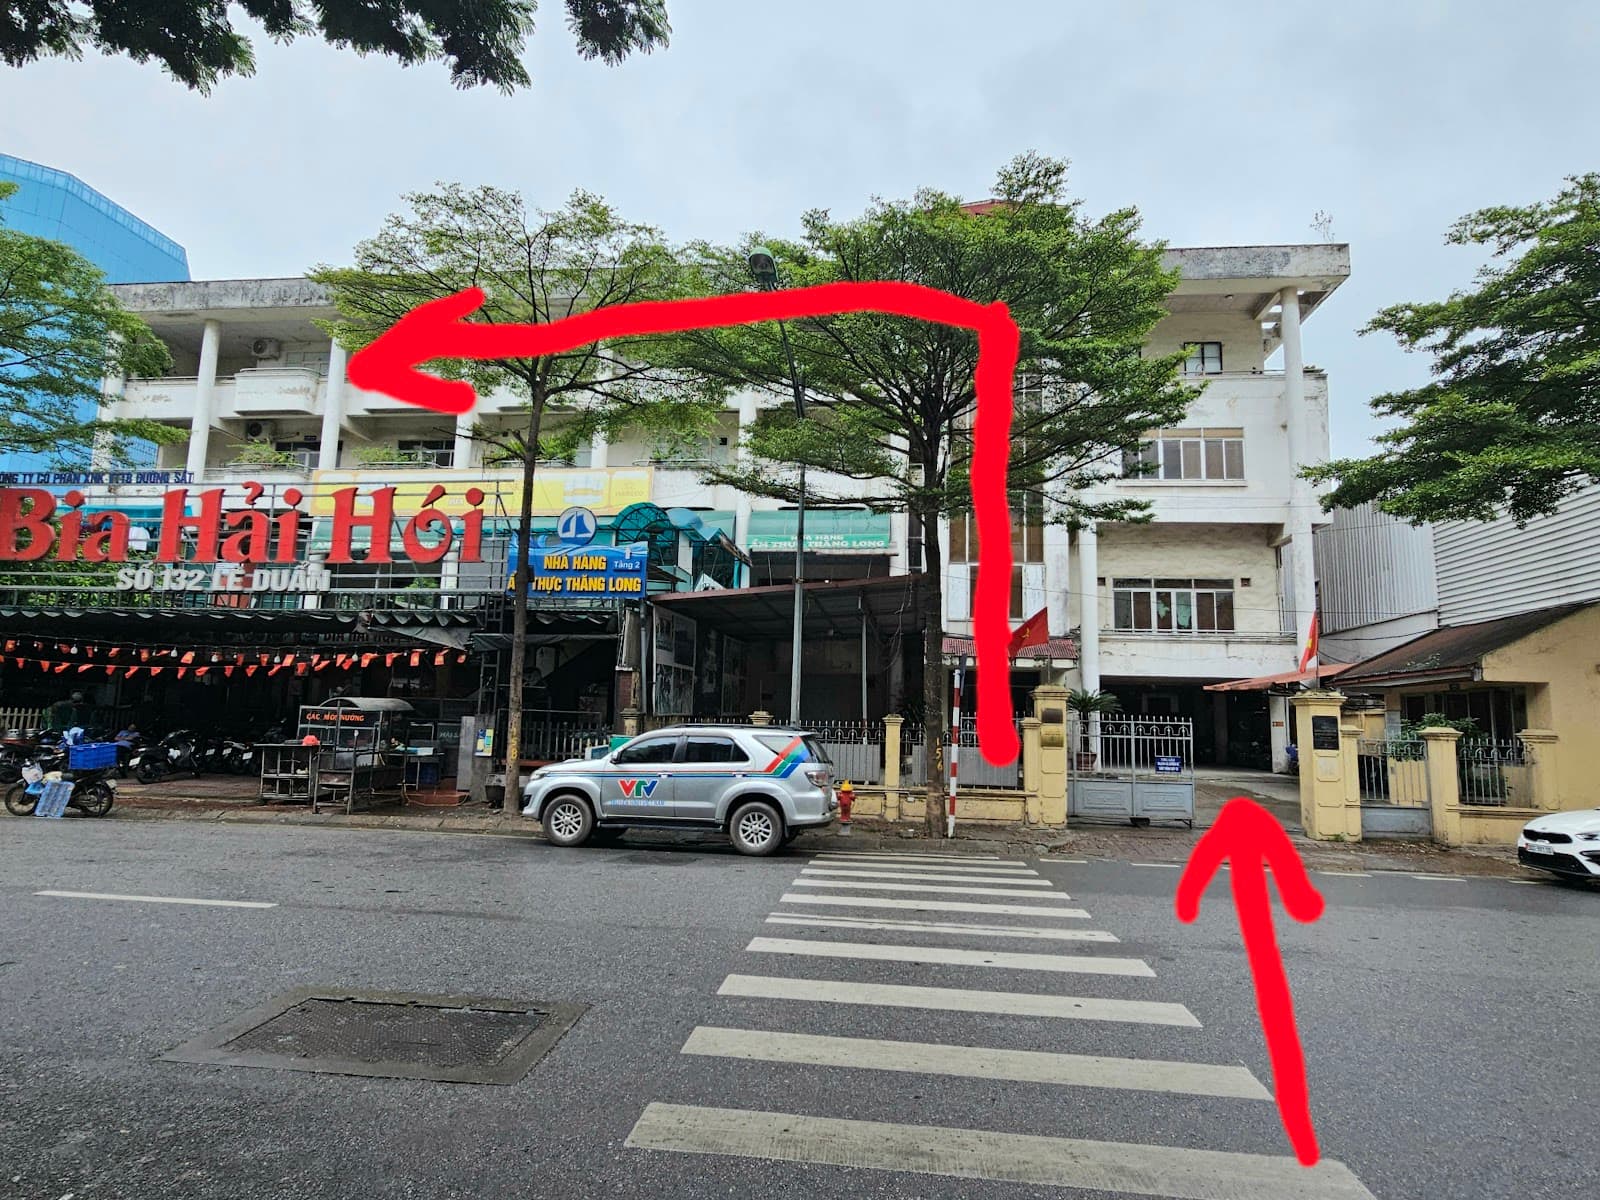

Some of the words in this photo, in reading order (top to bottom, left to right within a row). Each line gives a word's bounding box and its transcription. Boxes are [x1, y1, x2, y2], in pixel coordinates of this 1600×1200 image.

[0, 487, 130, 563] Bia
[154, 481, 303, 563] Hải
[544, 553, 570, 571] NHÀ
[572, 553, 607, 571] HÀNG
[634, 561, 641, 569] 2
[115, 562, 154, 591] SỐ
[157, 568, 207, 591] 132
[566, 574, 606, 592] THĂNG
[608, 576, 642, 592] LONG
[618, 779, 659, 798] VTV
